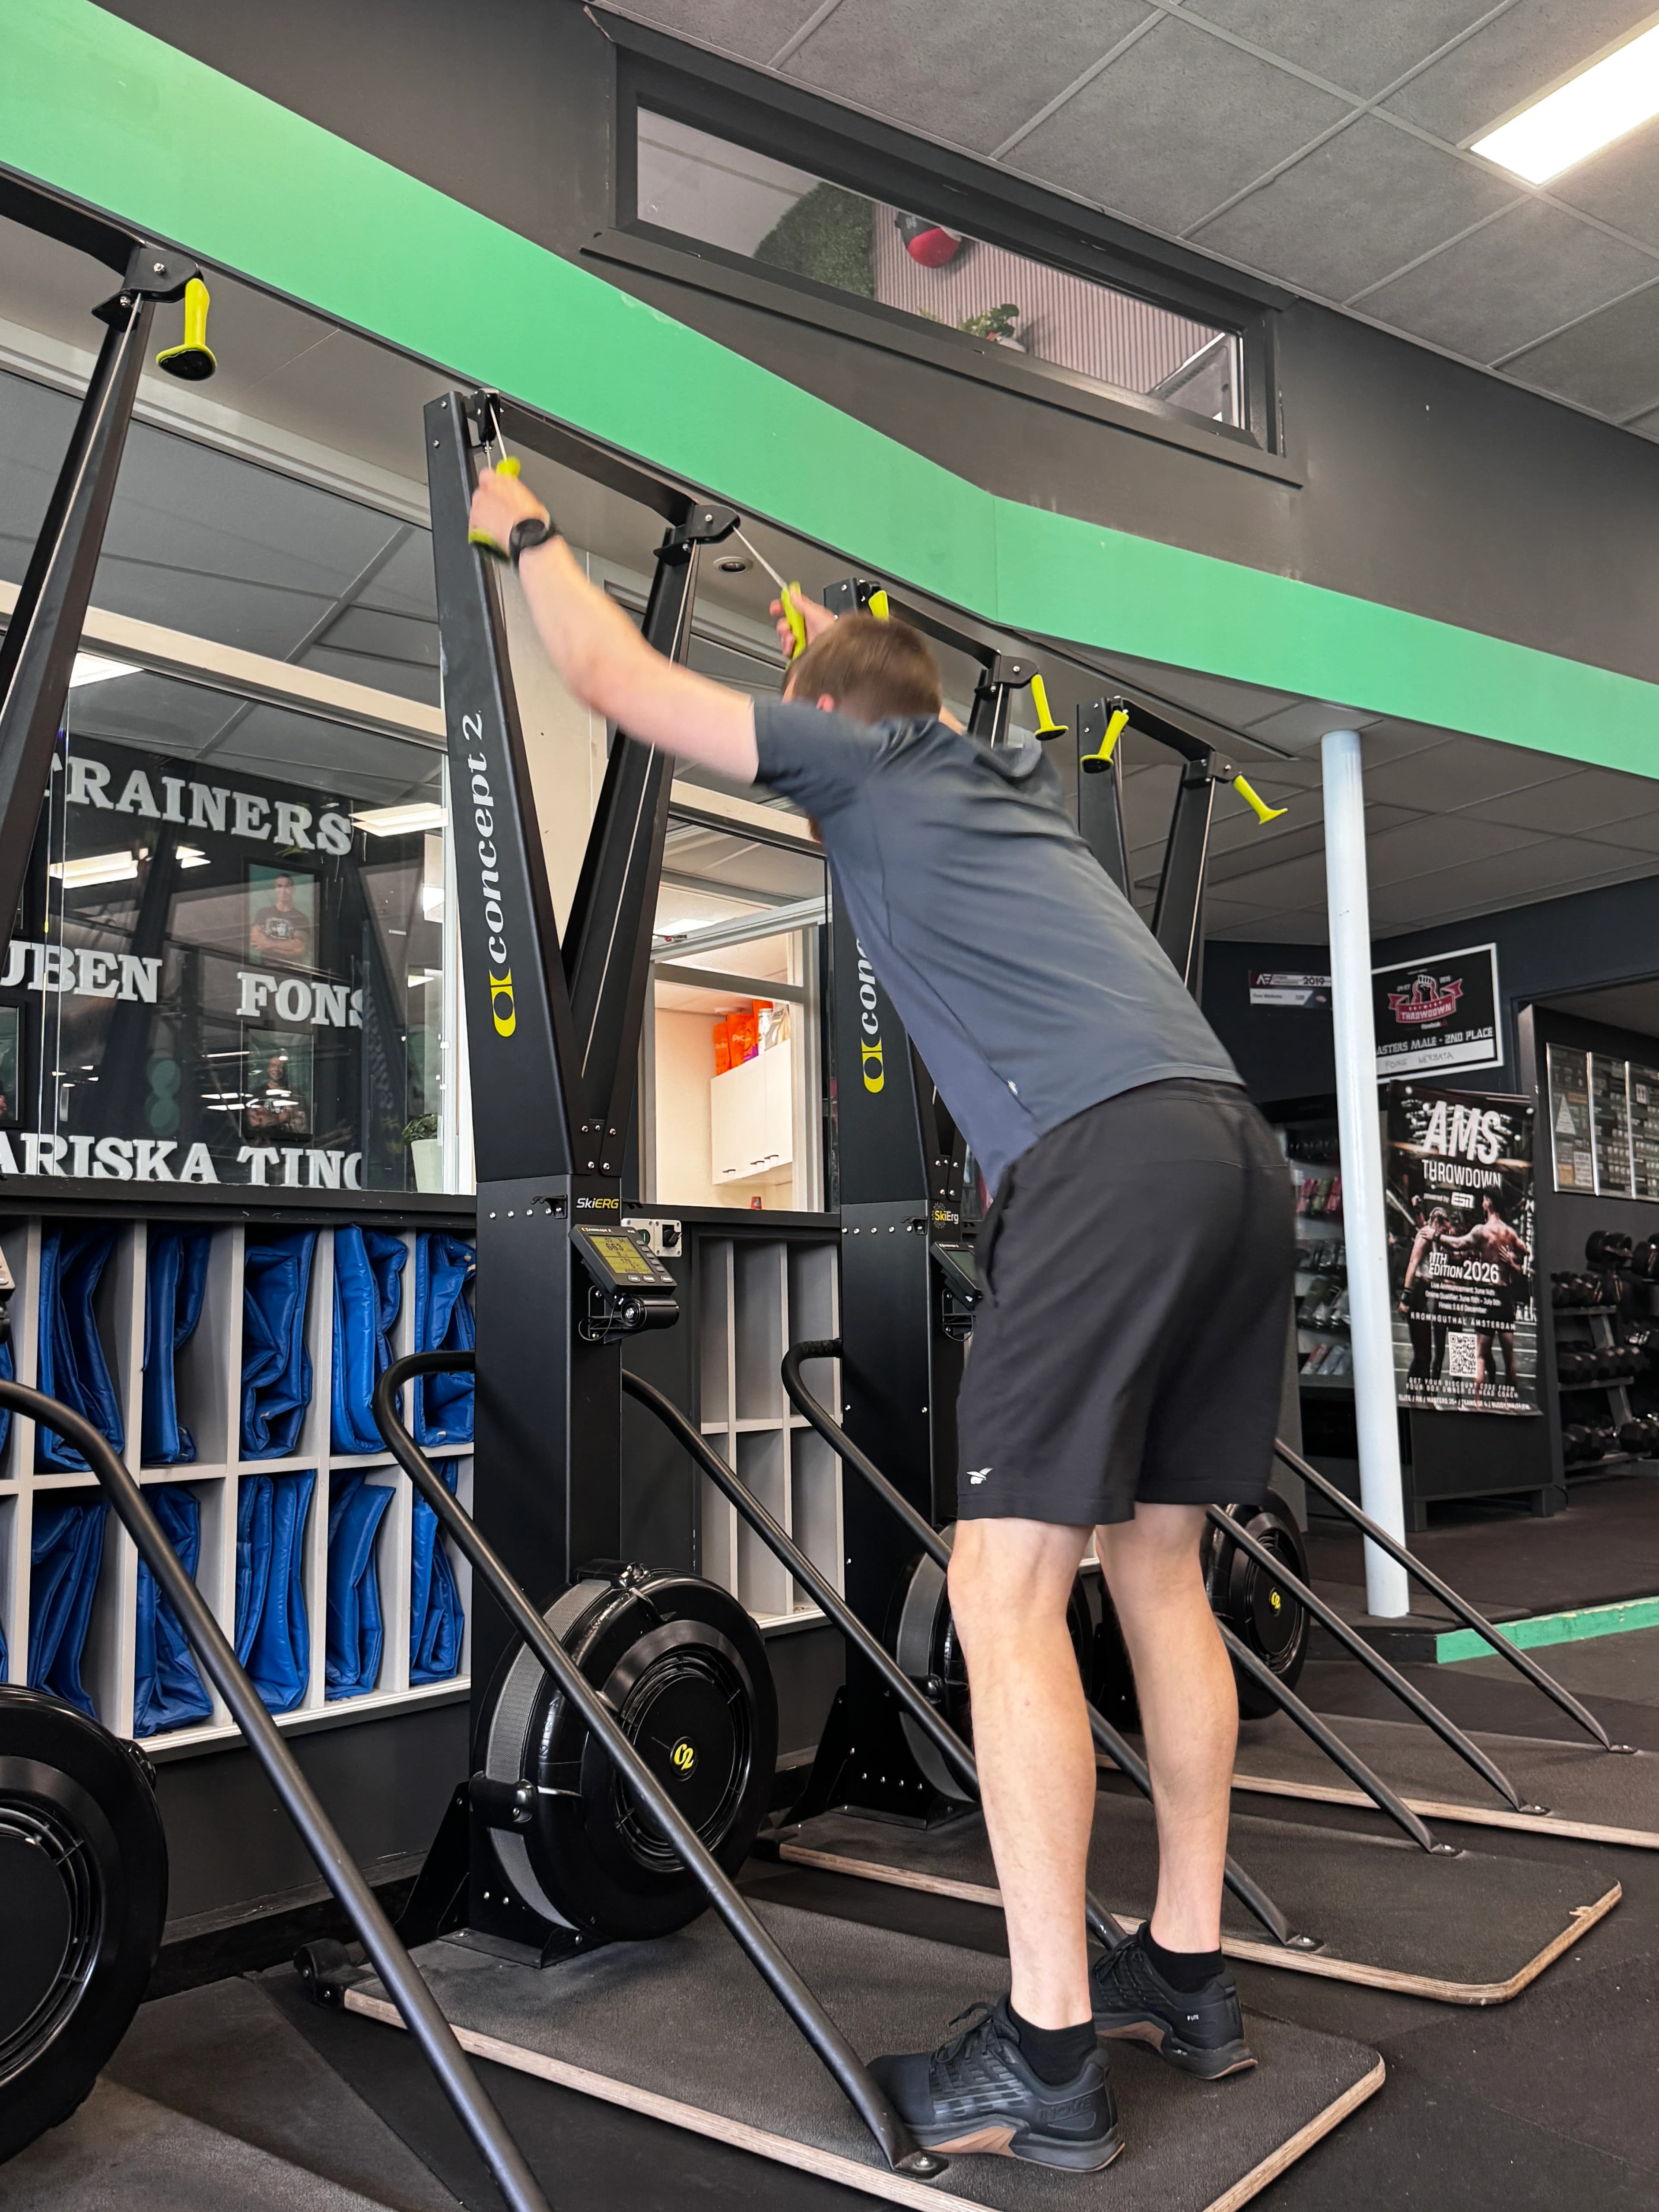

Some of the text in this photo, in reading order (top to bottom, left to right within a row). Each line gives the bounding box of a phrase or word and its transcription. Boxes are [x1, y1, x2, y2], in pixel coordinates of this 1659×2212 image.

[463, 713, 507, 964] concept 2
[1303, 976, 1325, 985] 2019
[1400, 1004, 1452, 1020] THROWDOWN
[1376, 1027, 1493, 1055] ASTERS MALE 2ND PLACE
[1423, 1100, 1501, 1164] AMS
[1421, 1159, 1501, 1189] THROWDOWN
[576, 1198, 620, 1209] SkiERG
[934, 1210, 959, 1224] SkiErg
[1429, 1263, 1463, 1279] EDITION
[1463, 1259, 1500, 1284] 2026
[1471, 1318, 1516, 1331] AMSTERDAM
[1442, 1386, 1464, 1394] OWNER
[1479, 1389, 1495, 1397] HEAD
[1497, 1390, 1519, 1398] COACH
[1445, 1379, 1477, 1389] DISCOUNT
